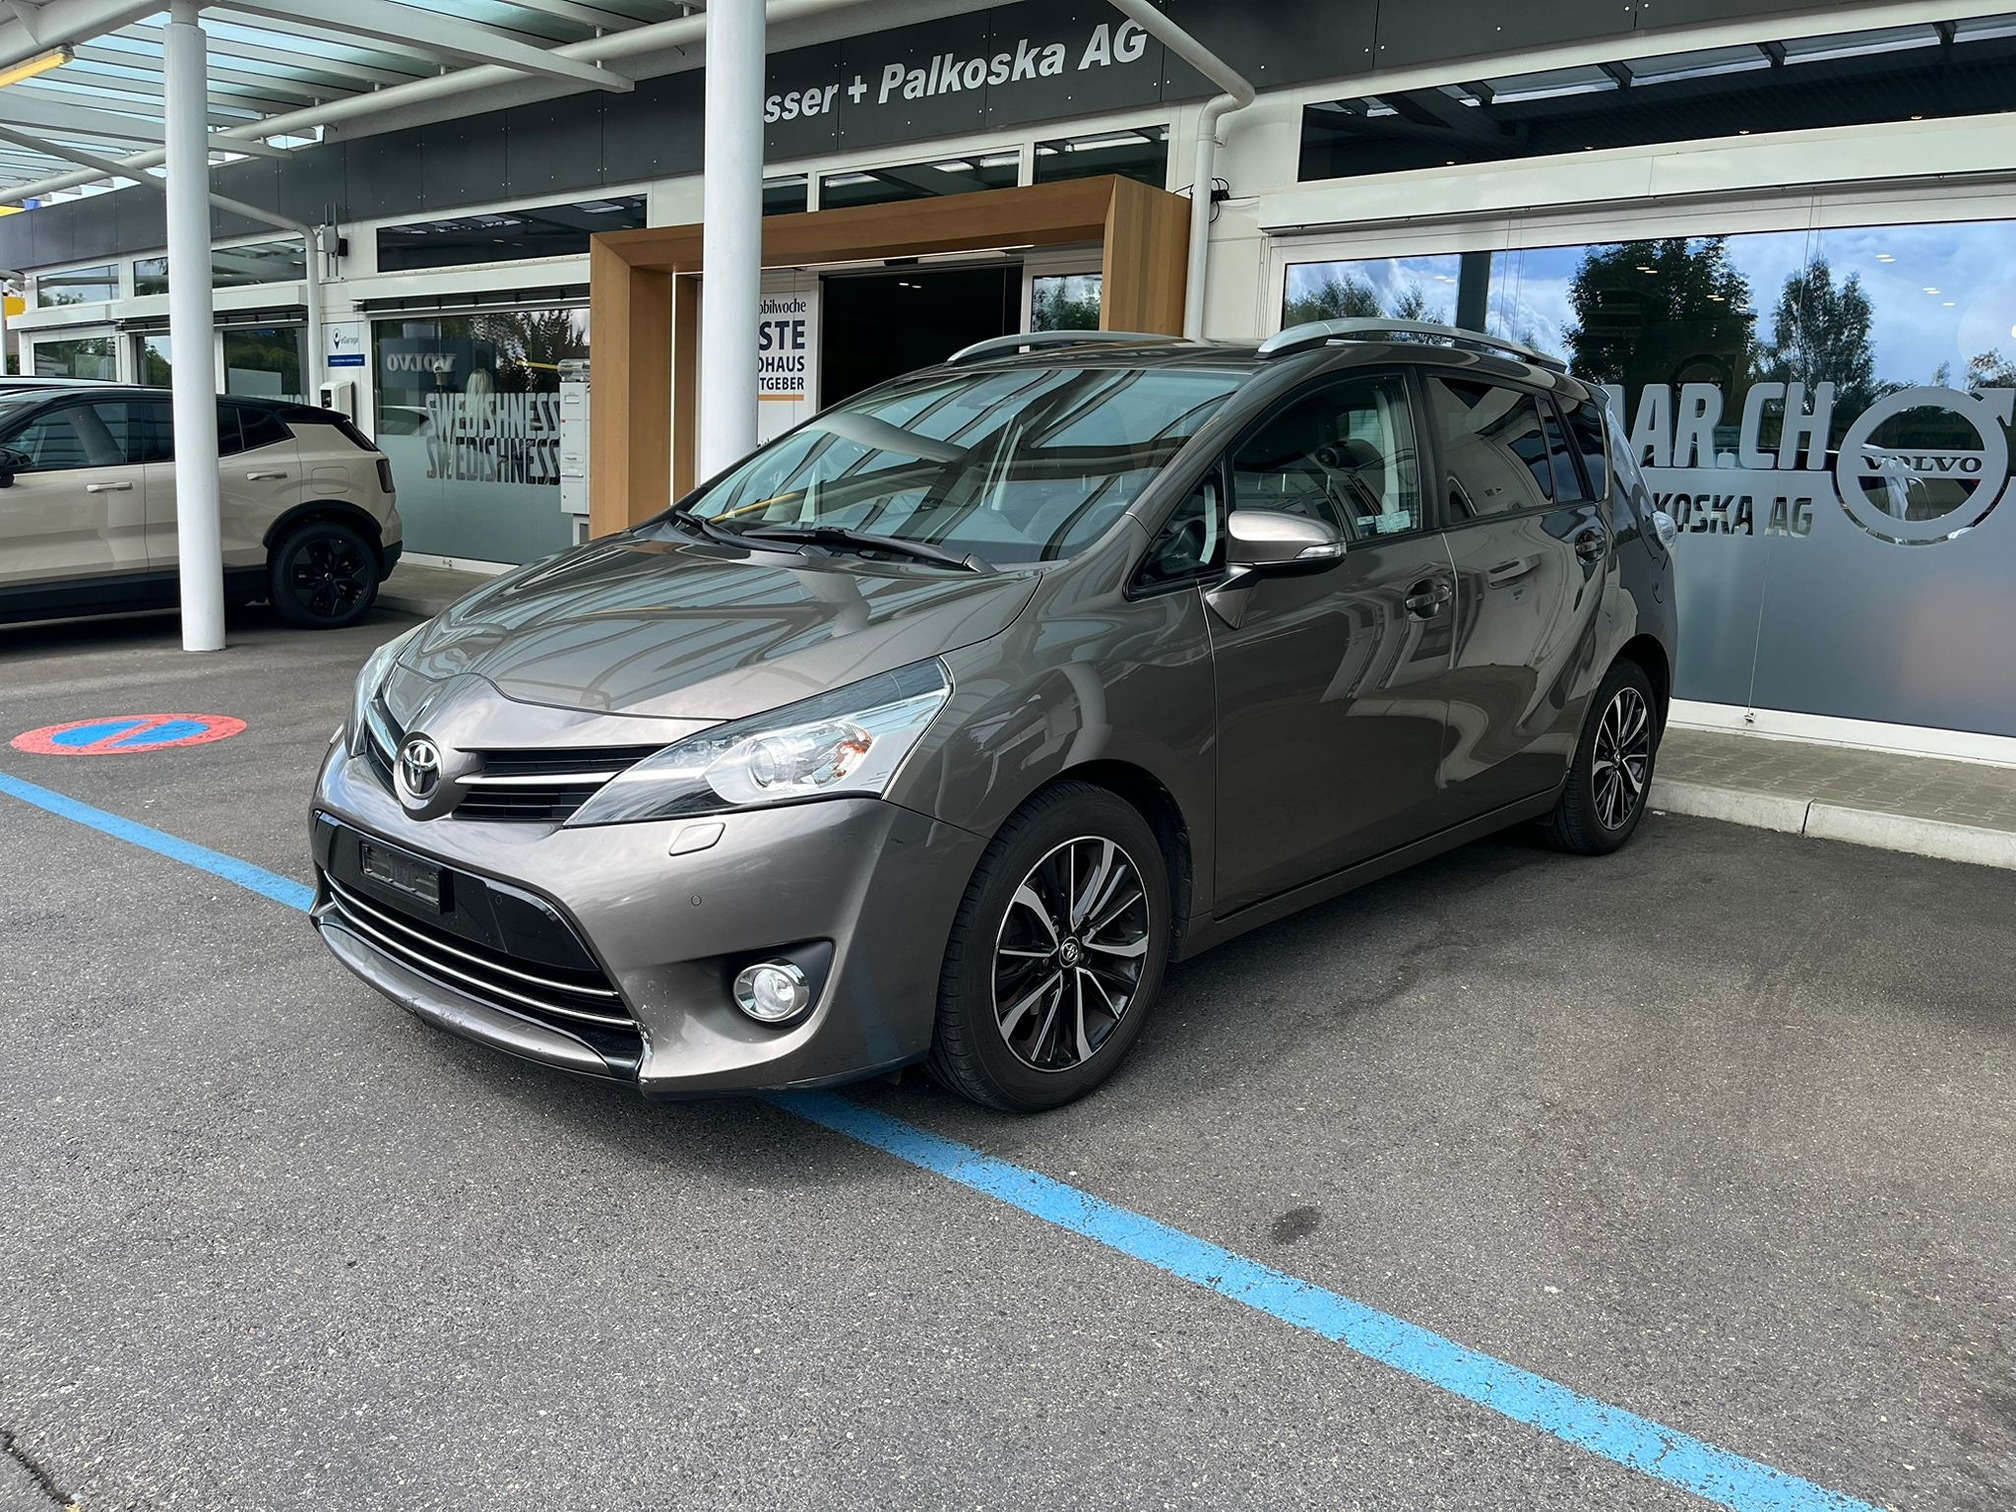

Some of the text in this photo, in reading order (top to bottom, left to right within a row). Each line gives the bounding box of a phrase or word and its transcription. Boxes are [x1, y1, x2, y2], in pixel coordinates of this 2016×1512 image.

[764, 83, 839, 123] sser
[878, 38, 1066, 104] Palkoska
[1077, 18, 1148, 71] AG
[759, 320, 806, 351] STE
[759, 377, 805, 391] TGEBER
[425, 392, 561, 440] SWEDISHNESS
[425, 436, 561, 486] SWEDISHNESS
[1652, 492, 1813, 538] KOSKA AG
